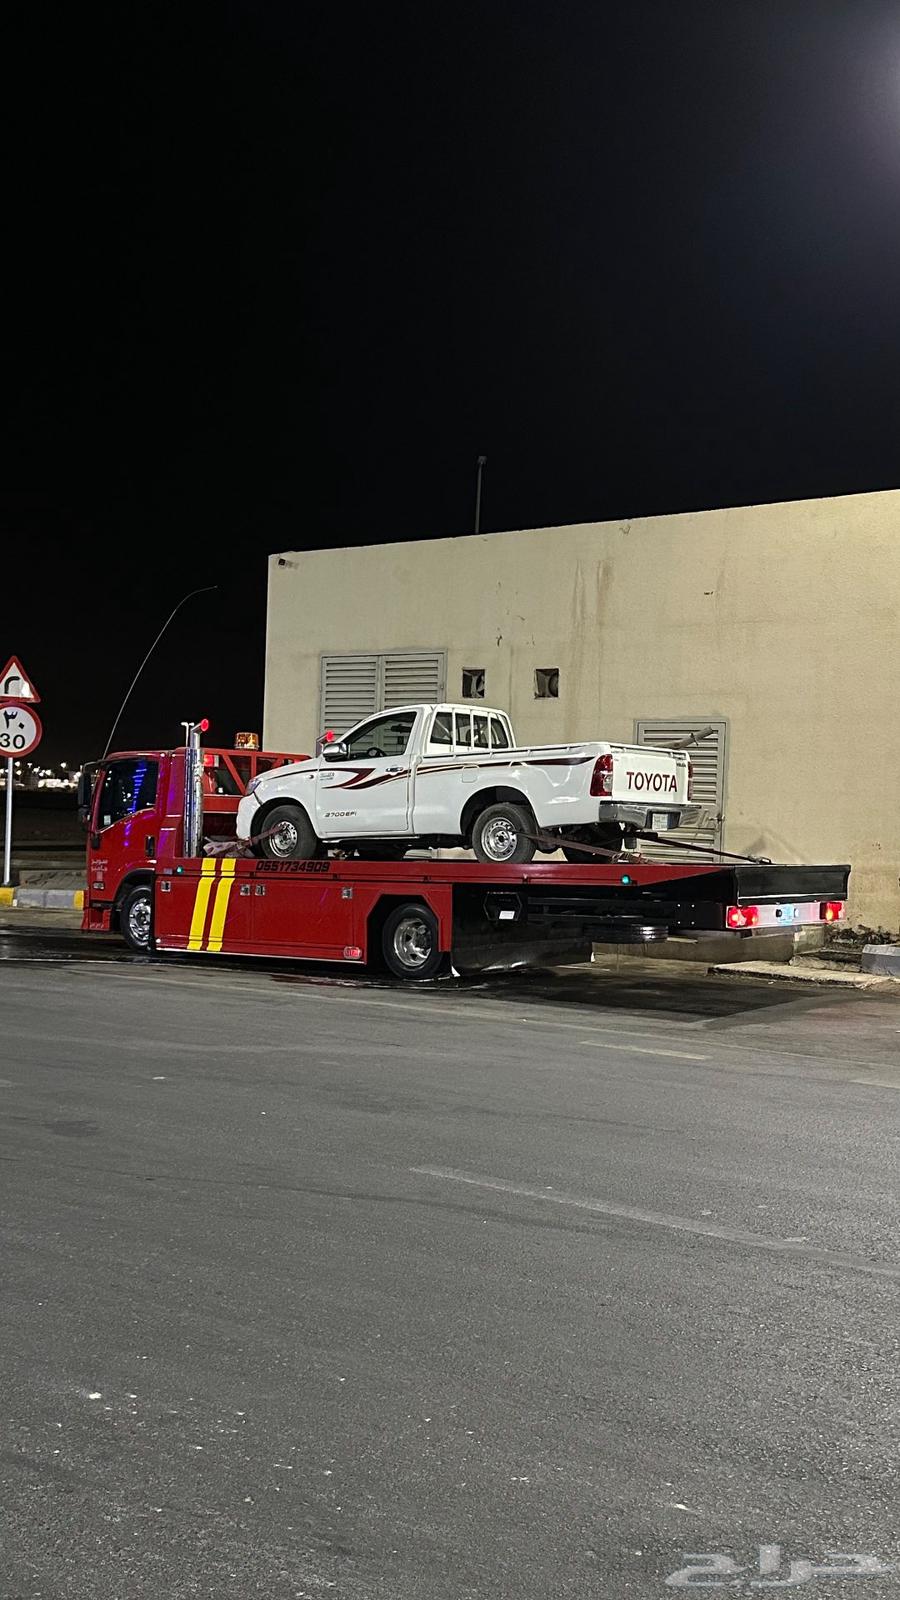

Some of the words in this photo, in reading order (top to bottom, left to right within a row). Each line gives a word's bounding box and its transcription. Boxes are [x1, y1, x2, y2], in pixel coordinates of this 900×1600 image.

[3, 710, 25, 729] ٣٠
[0, 733, 25, 749] 30
[626, 771, 677, 792] TOYOTA
[255, 860, 331, 872] 0551734909
